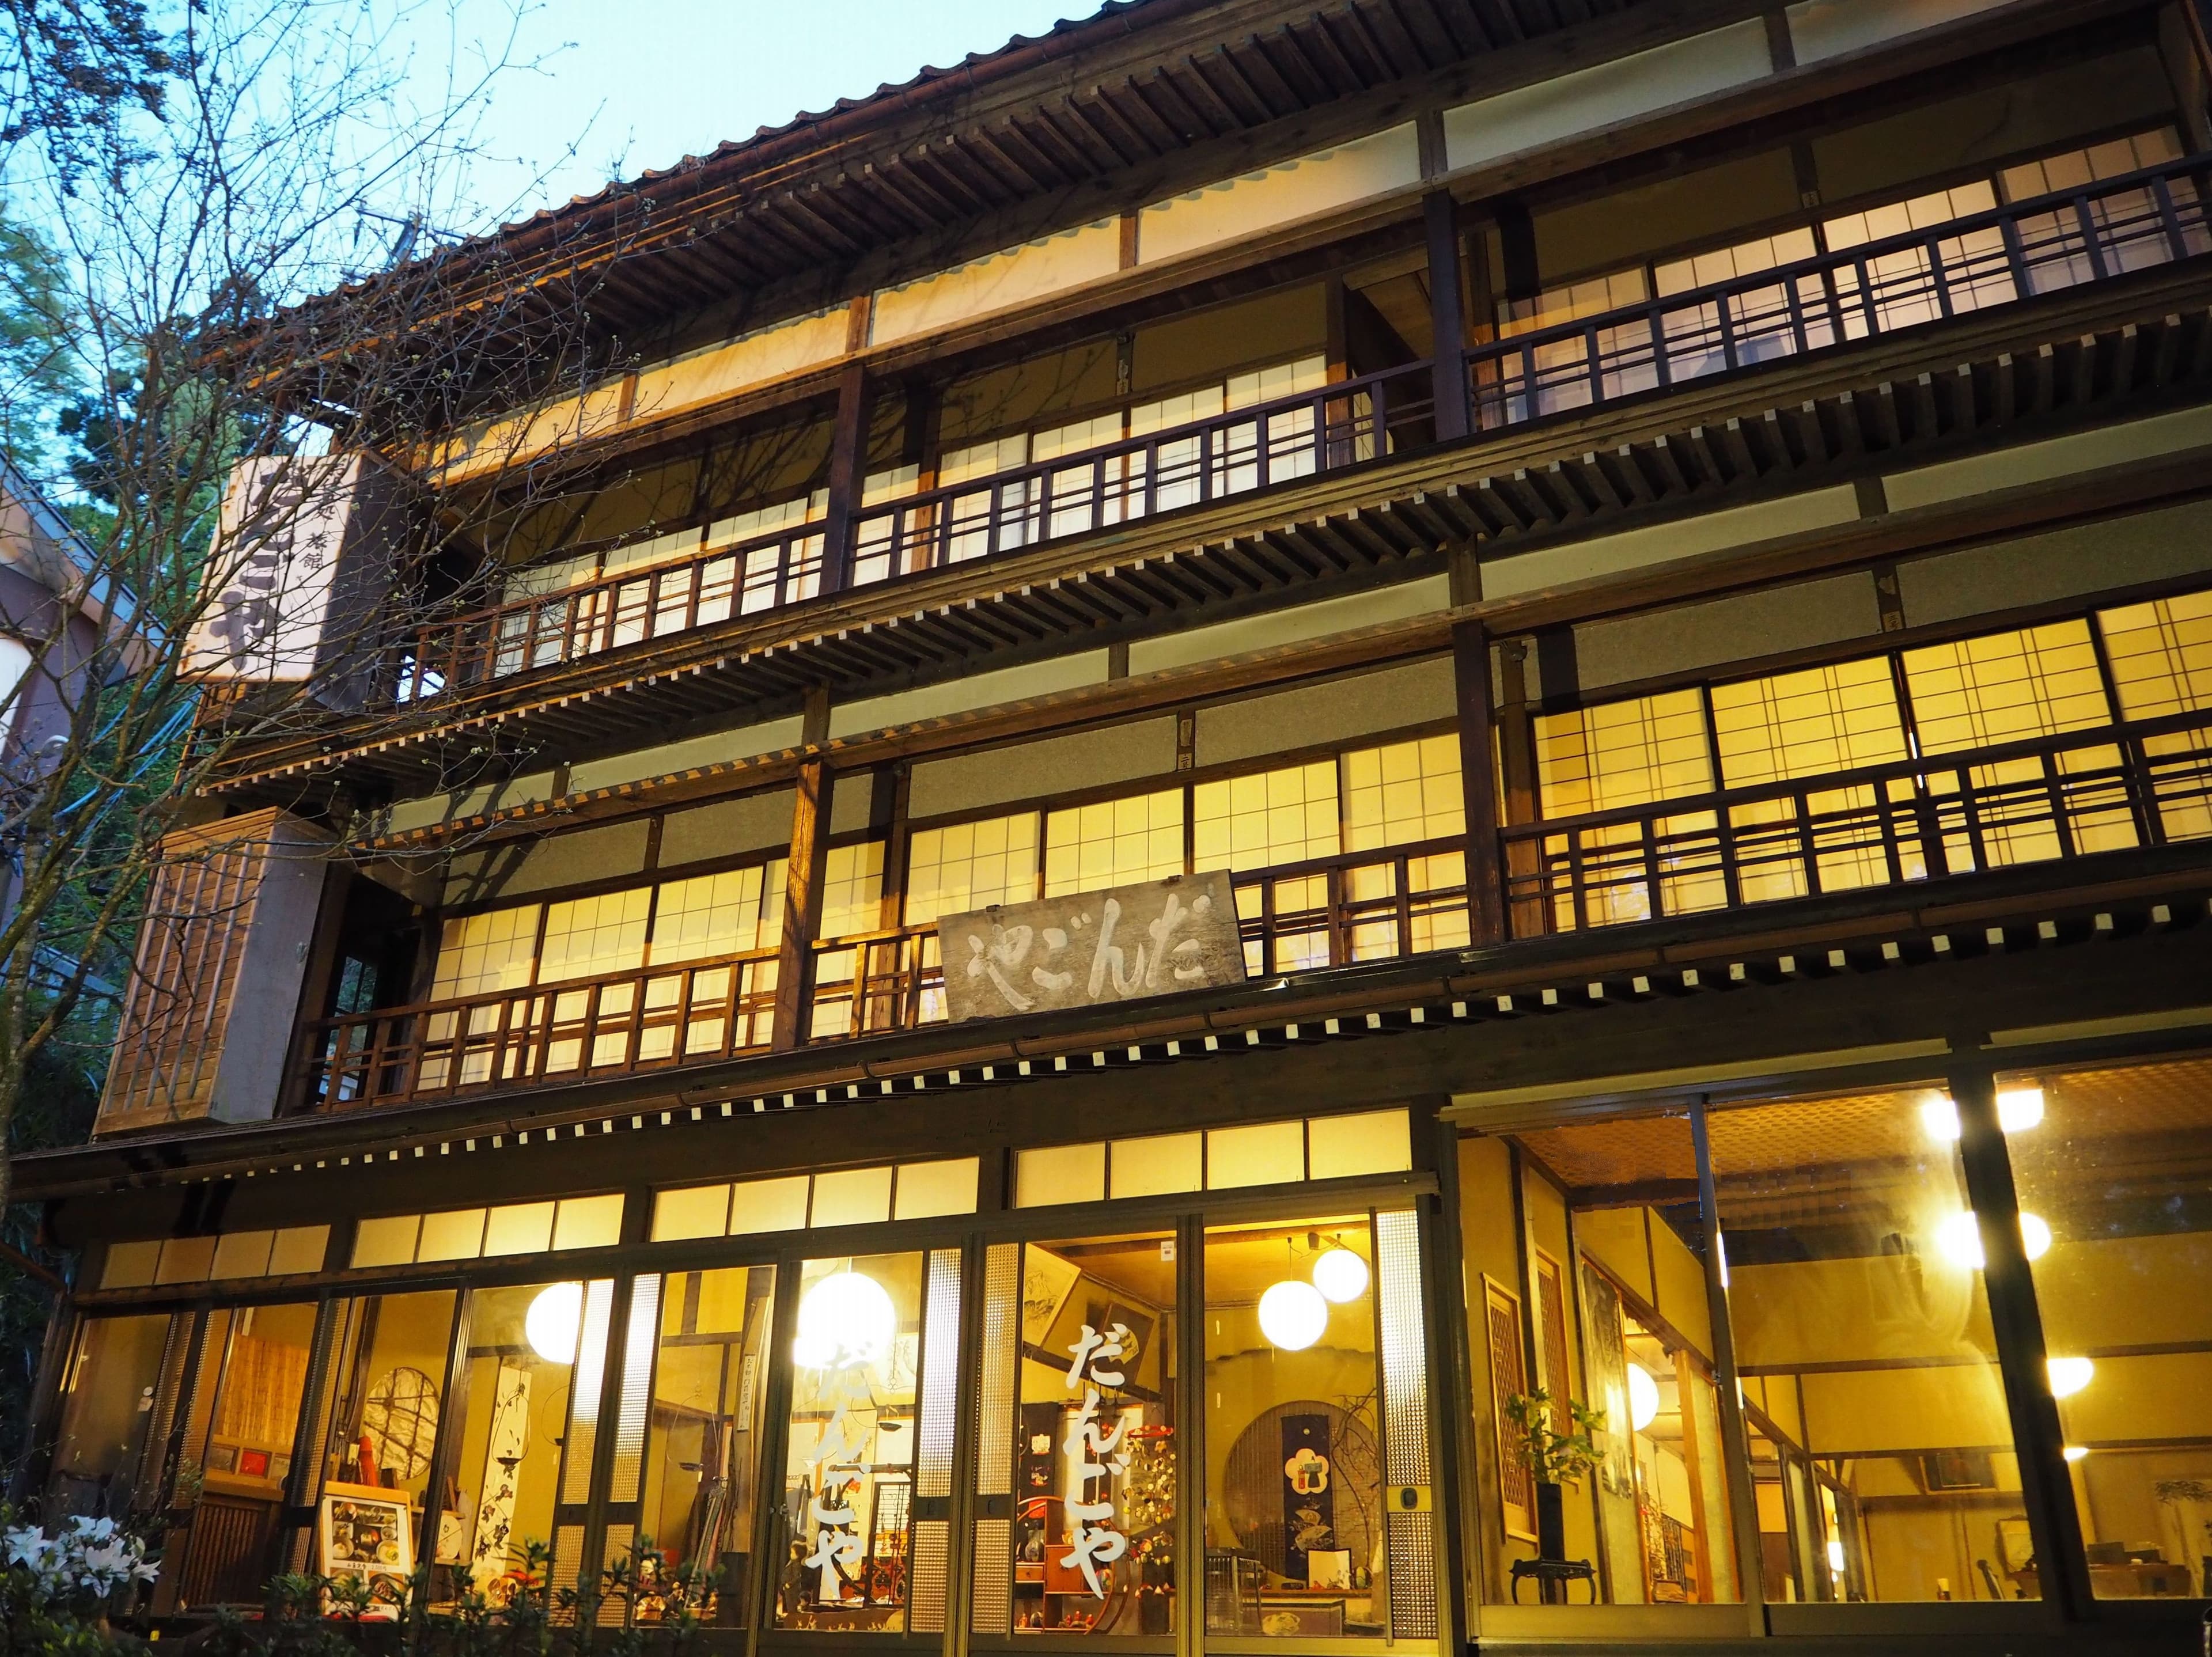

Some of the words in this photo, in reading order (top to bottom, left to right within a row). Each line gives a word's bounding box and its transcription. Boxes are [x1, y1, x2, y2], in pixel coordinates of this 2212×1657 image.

[805, 1342, 872, 1599] だんごや
[1059, 1323, 1130, 1599] だんごや
